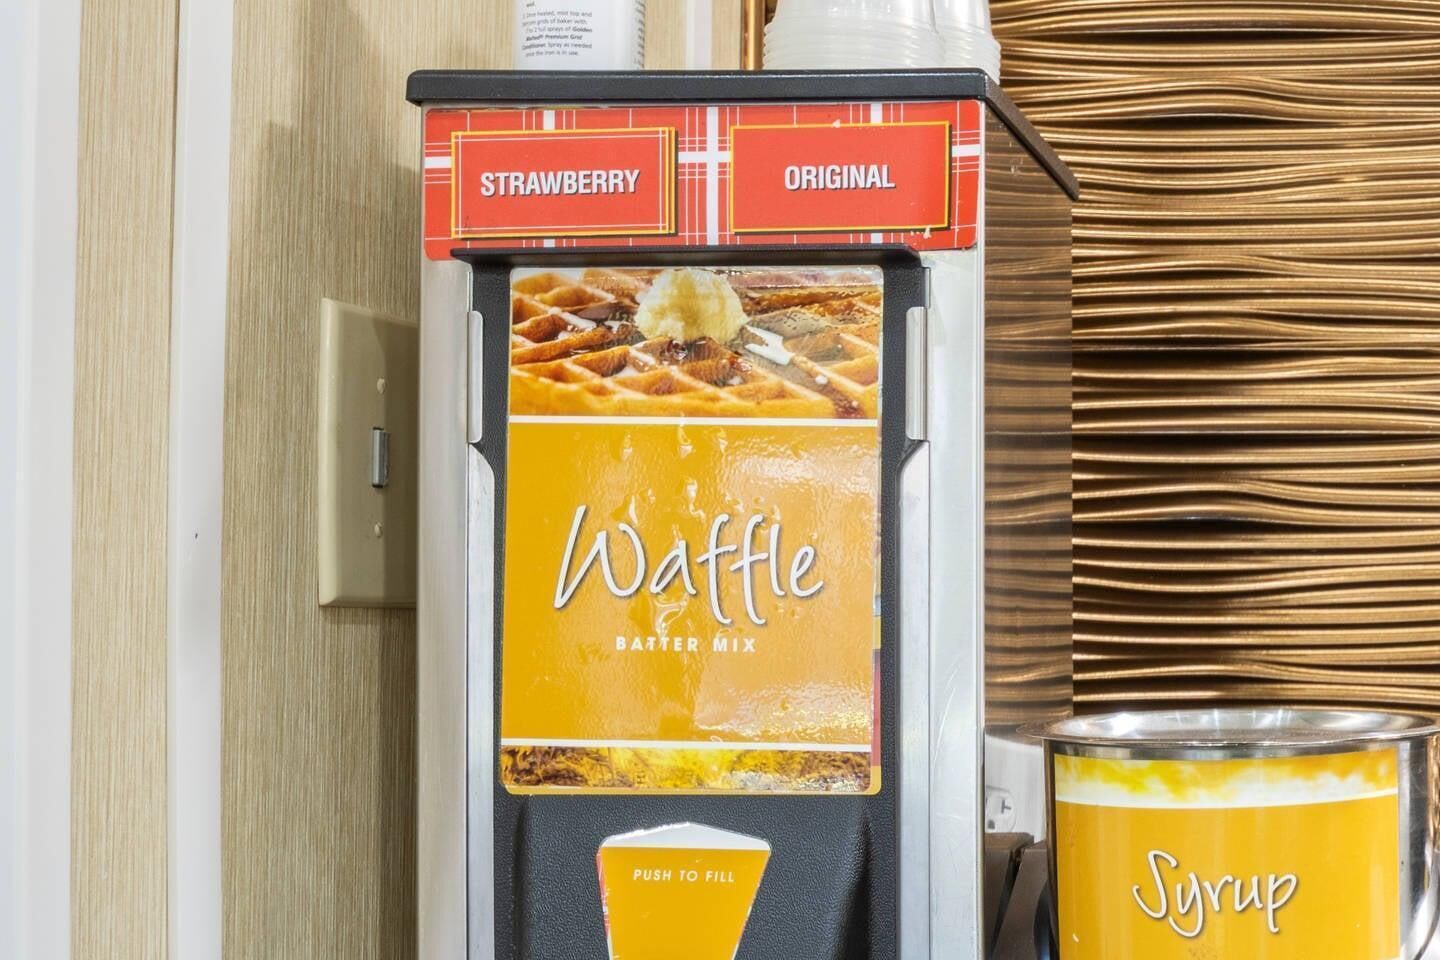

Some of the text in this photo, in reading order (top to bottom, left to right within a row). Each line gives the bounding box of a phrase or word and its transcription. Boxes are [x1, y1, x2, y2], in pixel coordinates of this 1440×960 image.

[480, 168, 641, 198] STRAWBERRY
[784, 164, 896, 192] ORIGINAL
[553, 504, 825, 627] Waffle
[616, 635, 757, 653] BATTER MIX
[633, 869, 735, 883] PUSH TO FILL
[1132, 849, 1298, 938] Syrup
